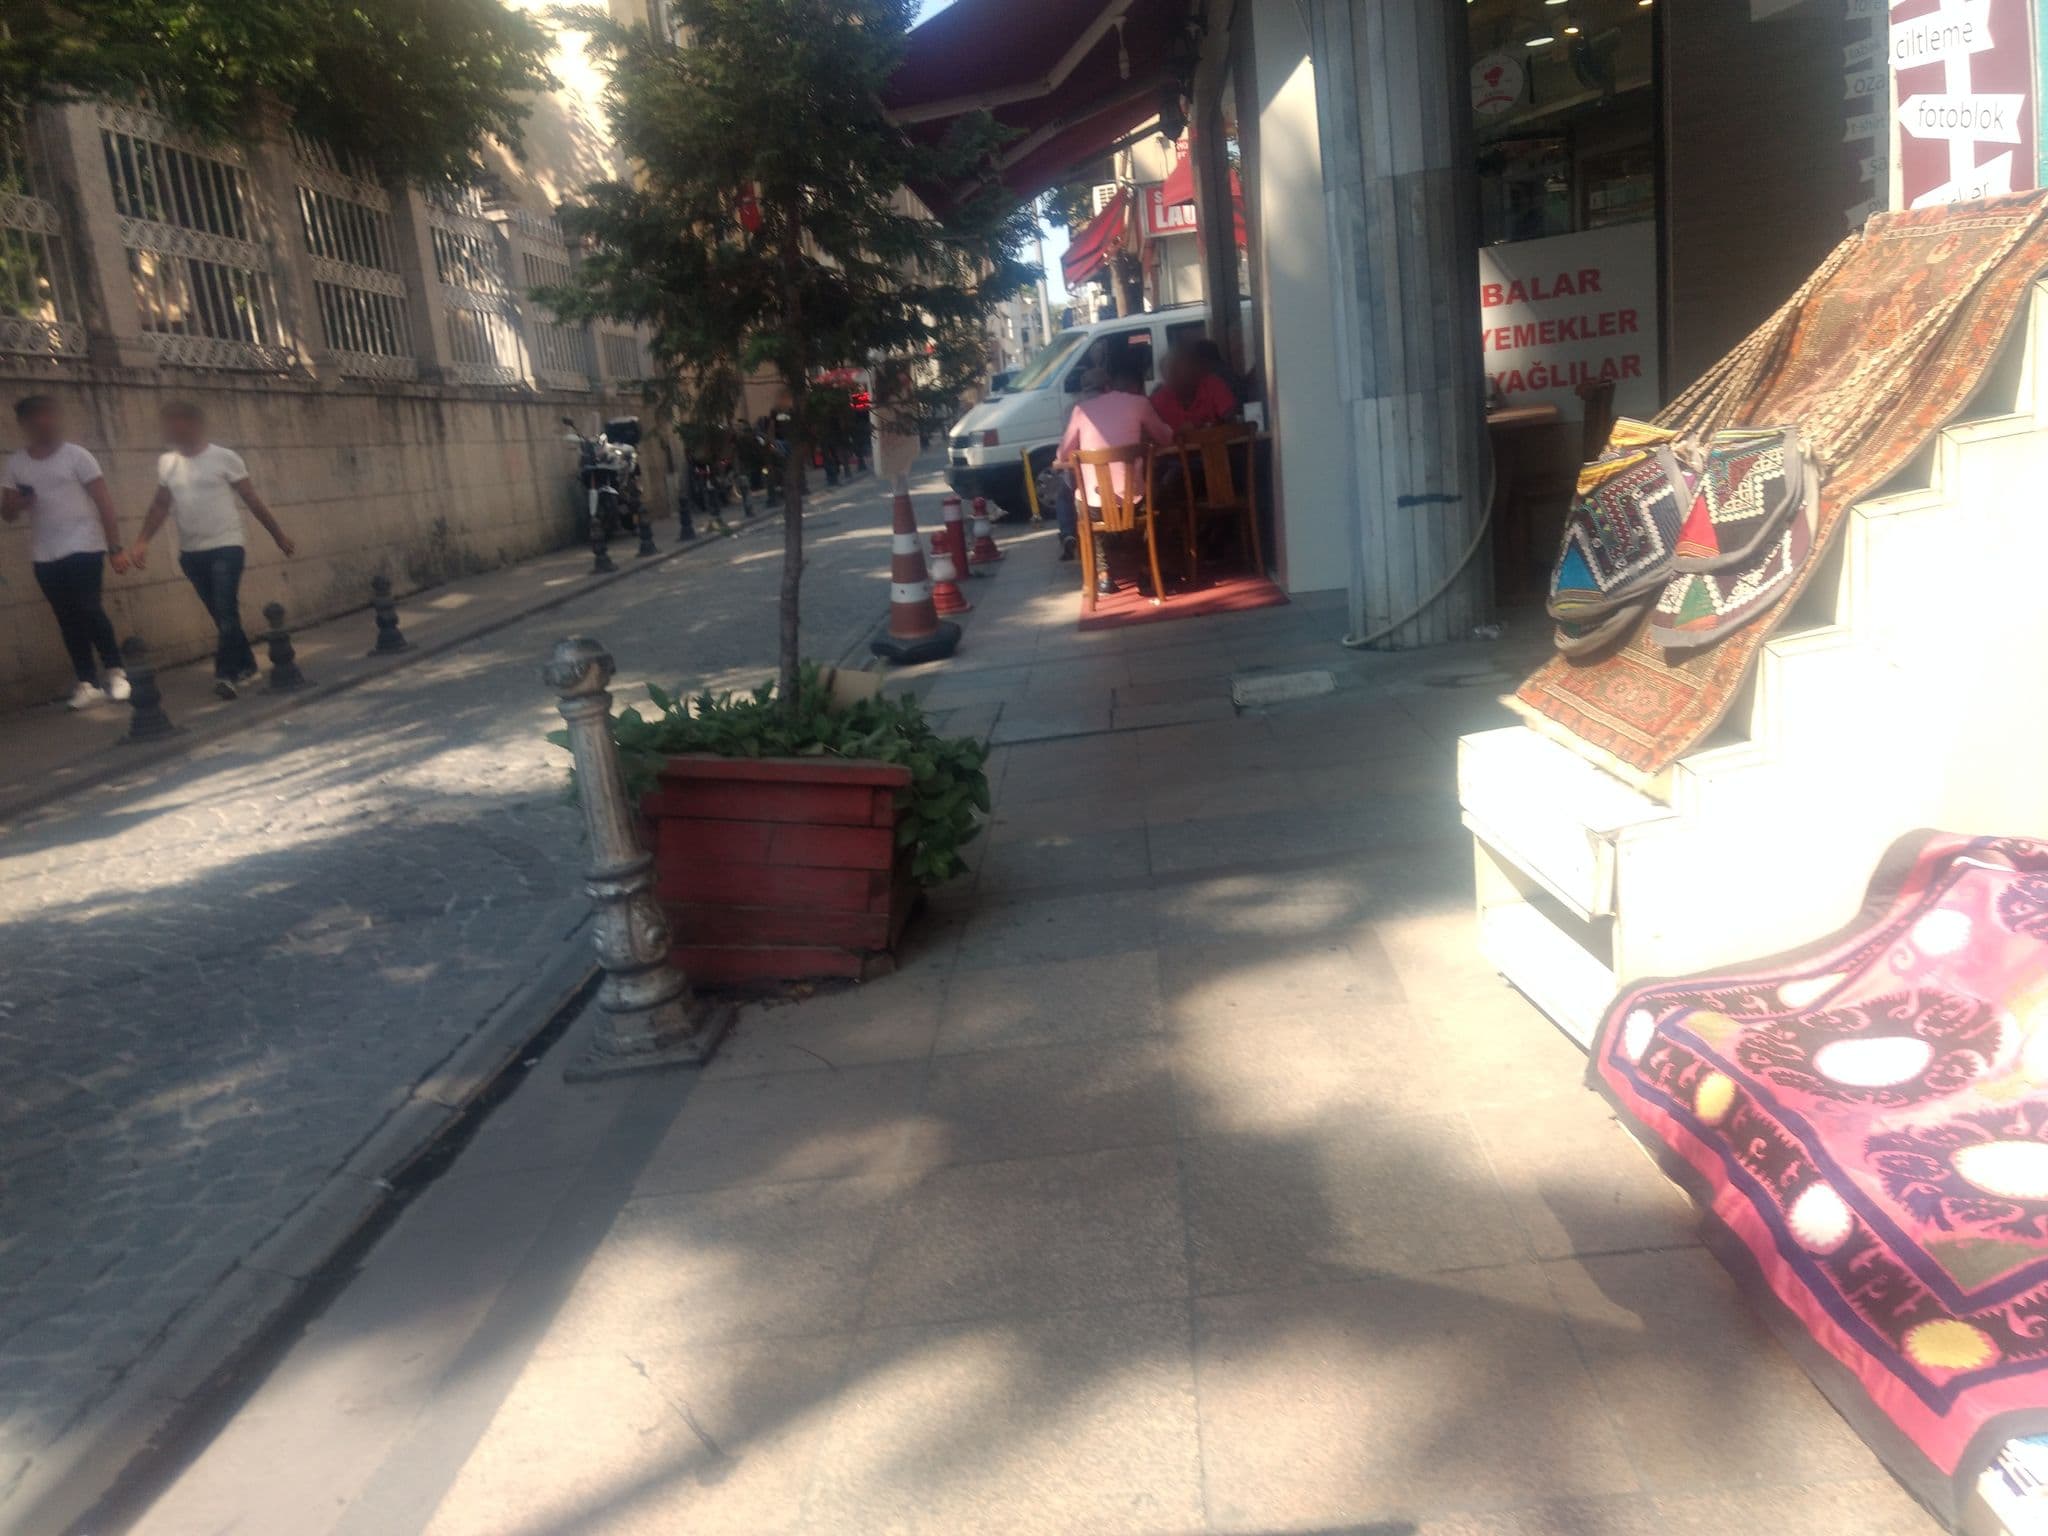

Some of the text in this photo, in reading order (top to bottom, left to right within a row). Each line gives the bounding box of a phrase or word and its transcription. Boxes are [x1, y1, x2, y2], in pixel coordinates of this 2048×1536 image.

[1896, 21, 1973, 59] ciltleme
[1918, 99, 2004, 130] fotoblok
[1481, 268, 1603, 308] BALAR
[1482, 309, 1639, 353] YEMEKLER
